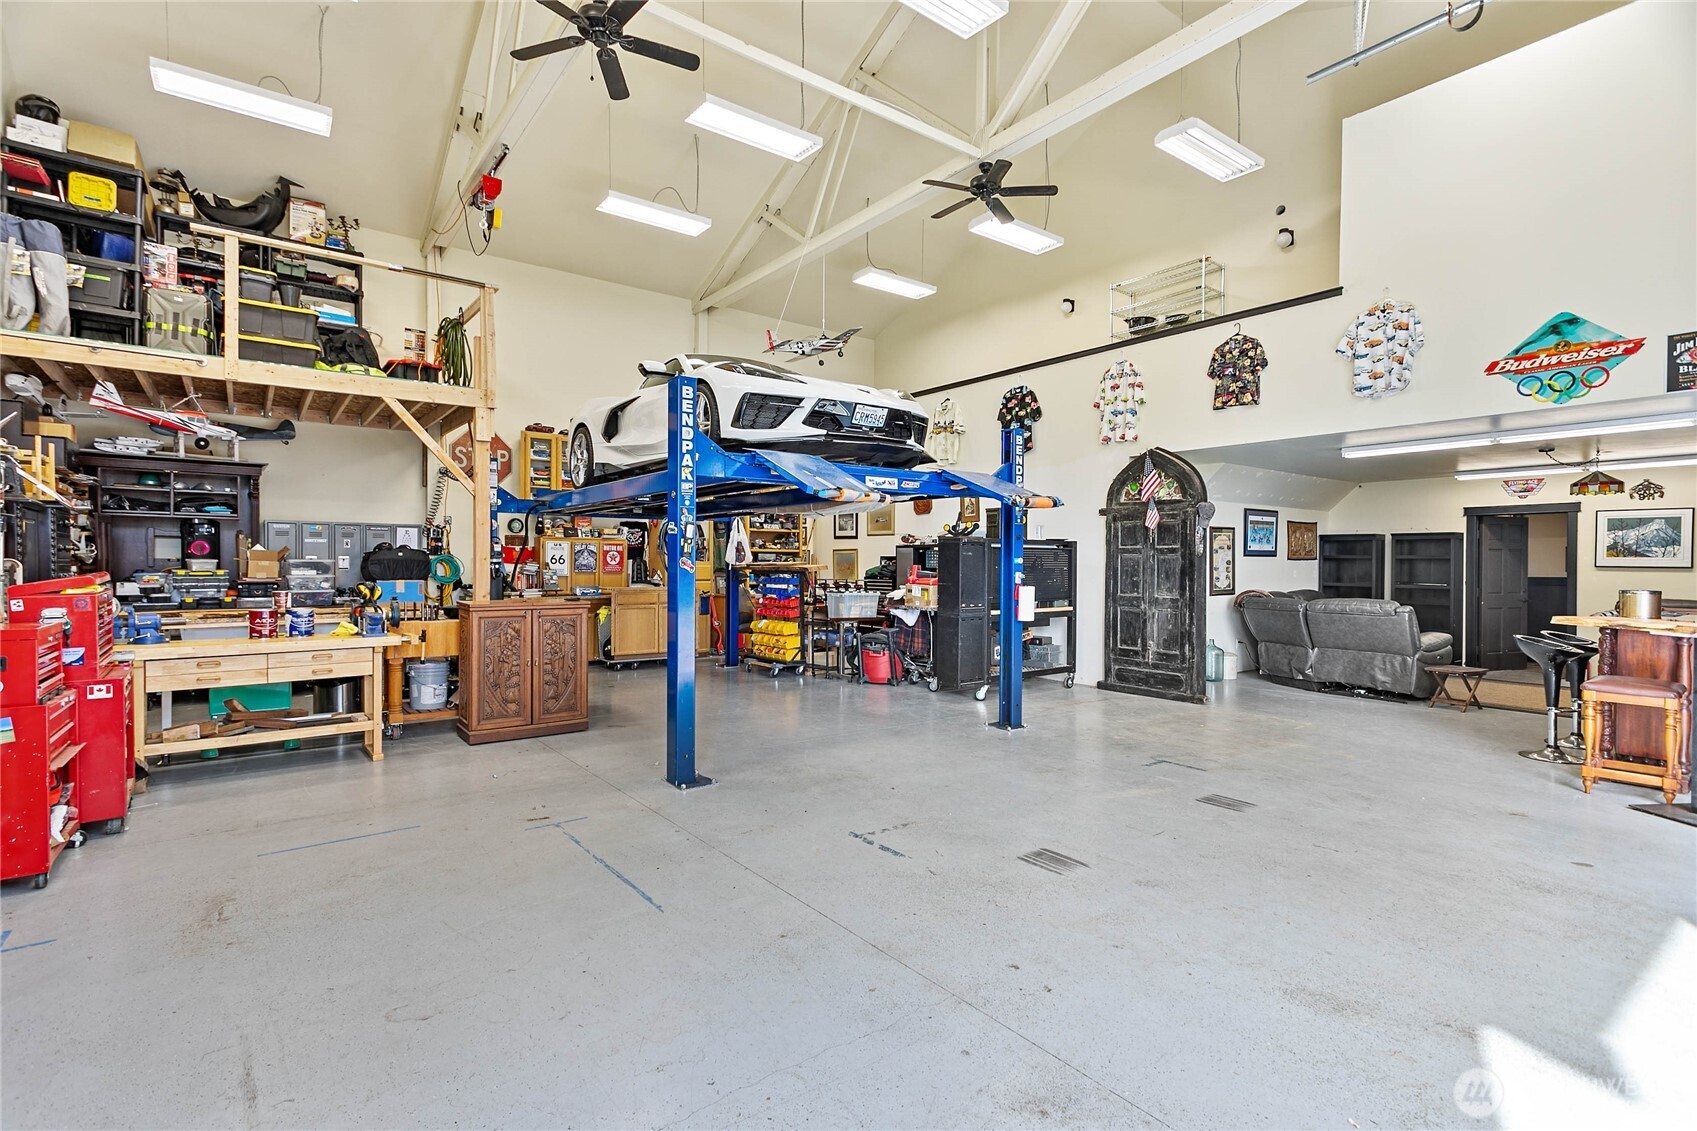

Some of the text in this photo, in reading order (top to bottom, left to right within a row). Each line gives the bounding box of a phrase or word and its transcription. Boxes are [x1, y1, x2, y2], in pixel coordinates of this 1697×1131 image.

[1673, 340, 1694, 356] JIM
[1492, 343, 1635, 373] Budweiser
[854, 411, 885, 426] CRM5945
[681, 385, 694, 480] BENDPAK
[550, 554, 566, 565] 66
